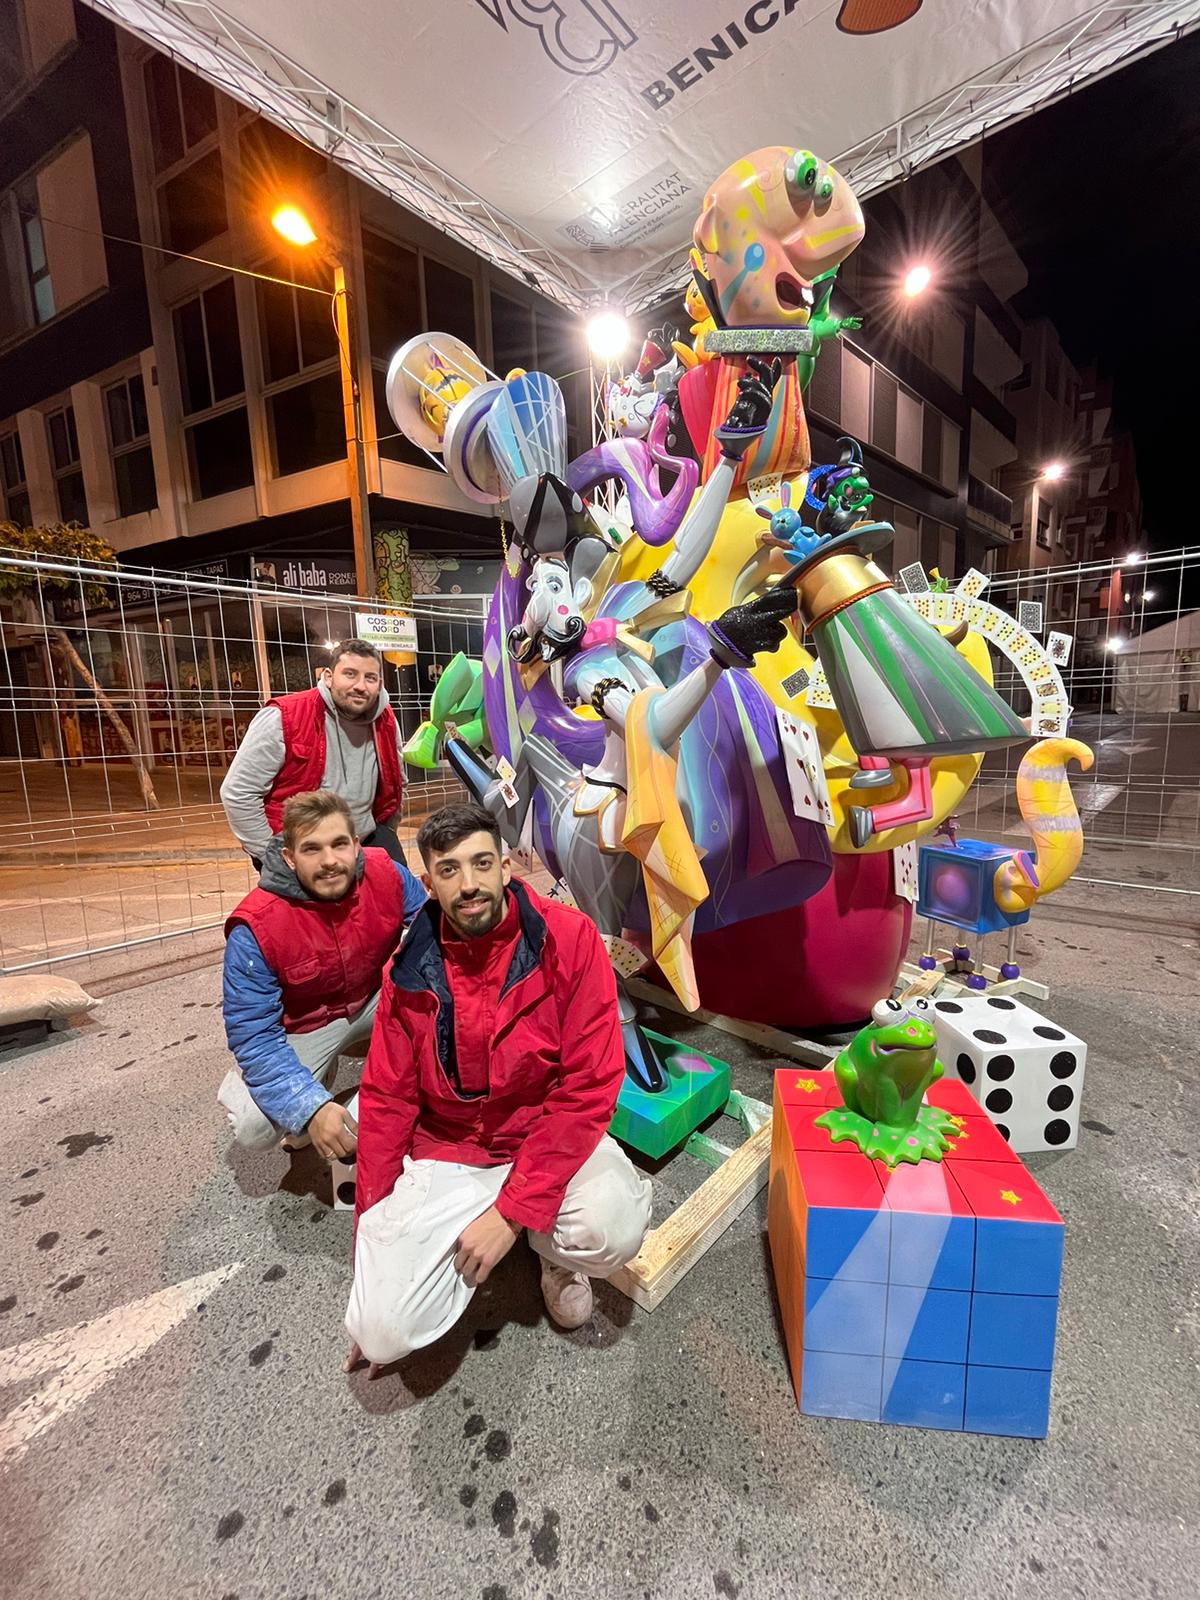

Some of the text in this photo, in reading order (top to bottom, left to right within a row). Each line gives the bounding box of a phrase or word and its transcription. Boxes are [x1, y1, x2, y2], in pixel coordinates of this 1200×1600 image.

[639, 0, 801, 111] BENIC
[283, 562, 326, 586] ali baba
